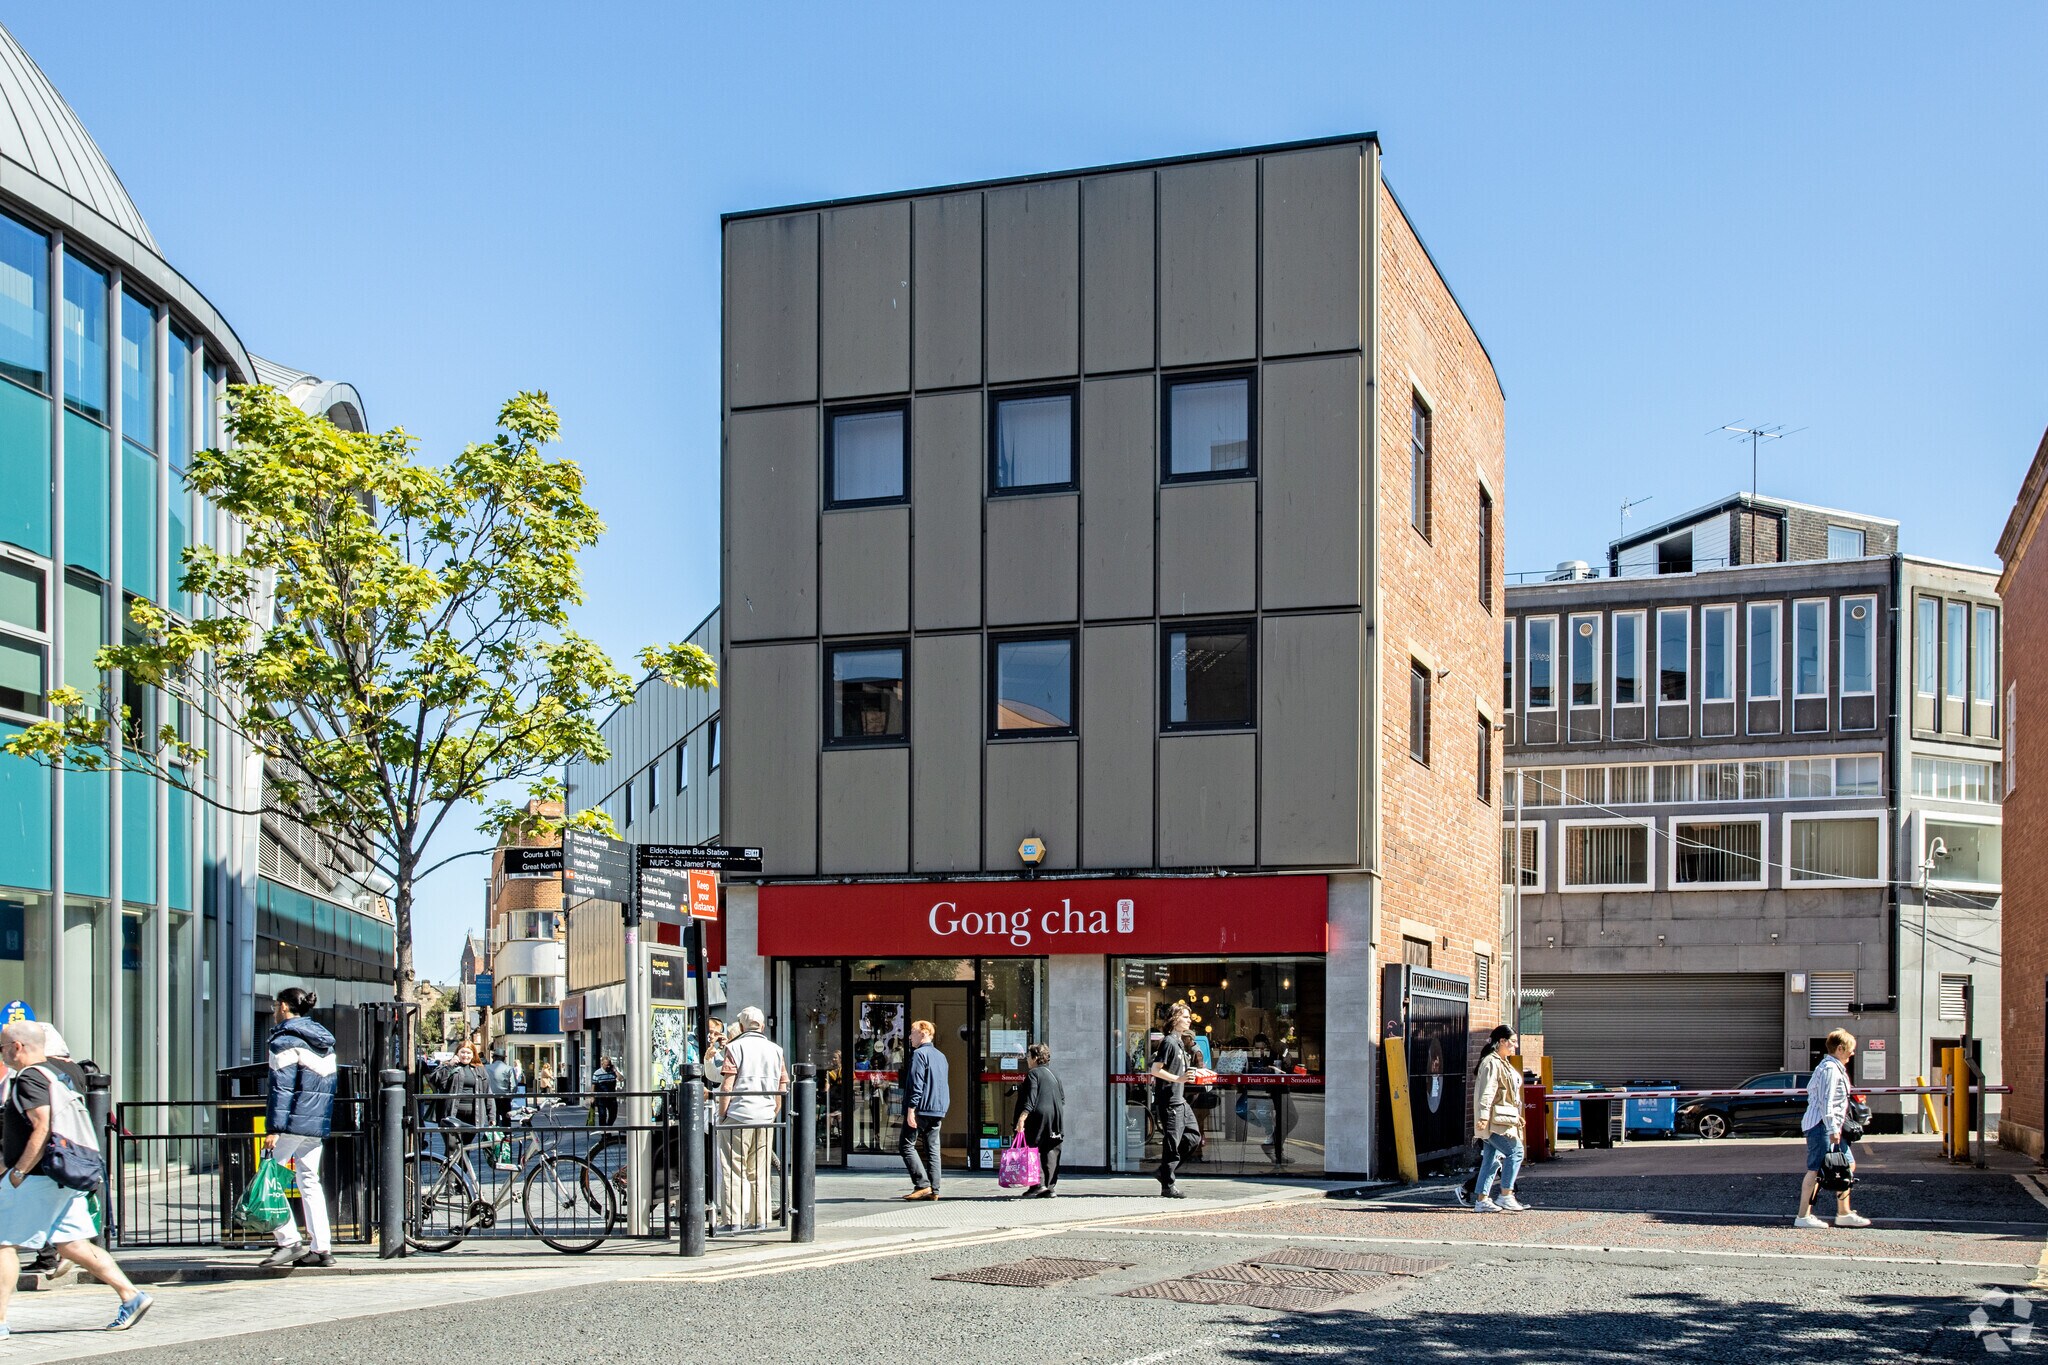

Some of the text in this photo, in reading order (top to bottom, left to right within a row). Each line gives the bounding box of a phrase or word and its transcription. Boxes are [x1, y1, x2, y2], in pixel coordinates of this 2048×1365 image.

[574, 832, 608, 850] Newcastle University
[523, 851, 544, 859] Courts
[590, 848, 600, 859] Stage
[669, 847, 691, 856] Square
[683, 860, 705, 868] James'
[697, 880, 710, 891] Keep
[698, 893, 710, 901] your
[693, 902, 716, 913] distance
[928, 898, 1111, 948] Gong cha
[1290, 1076, 1321, 1084] Smoothies
